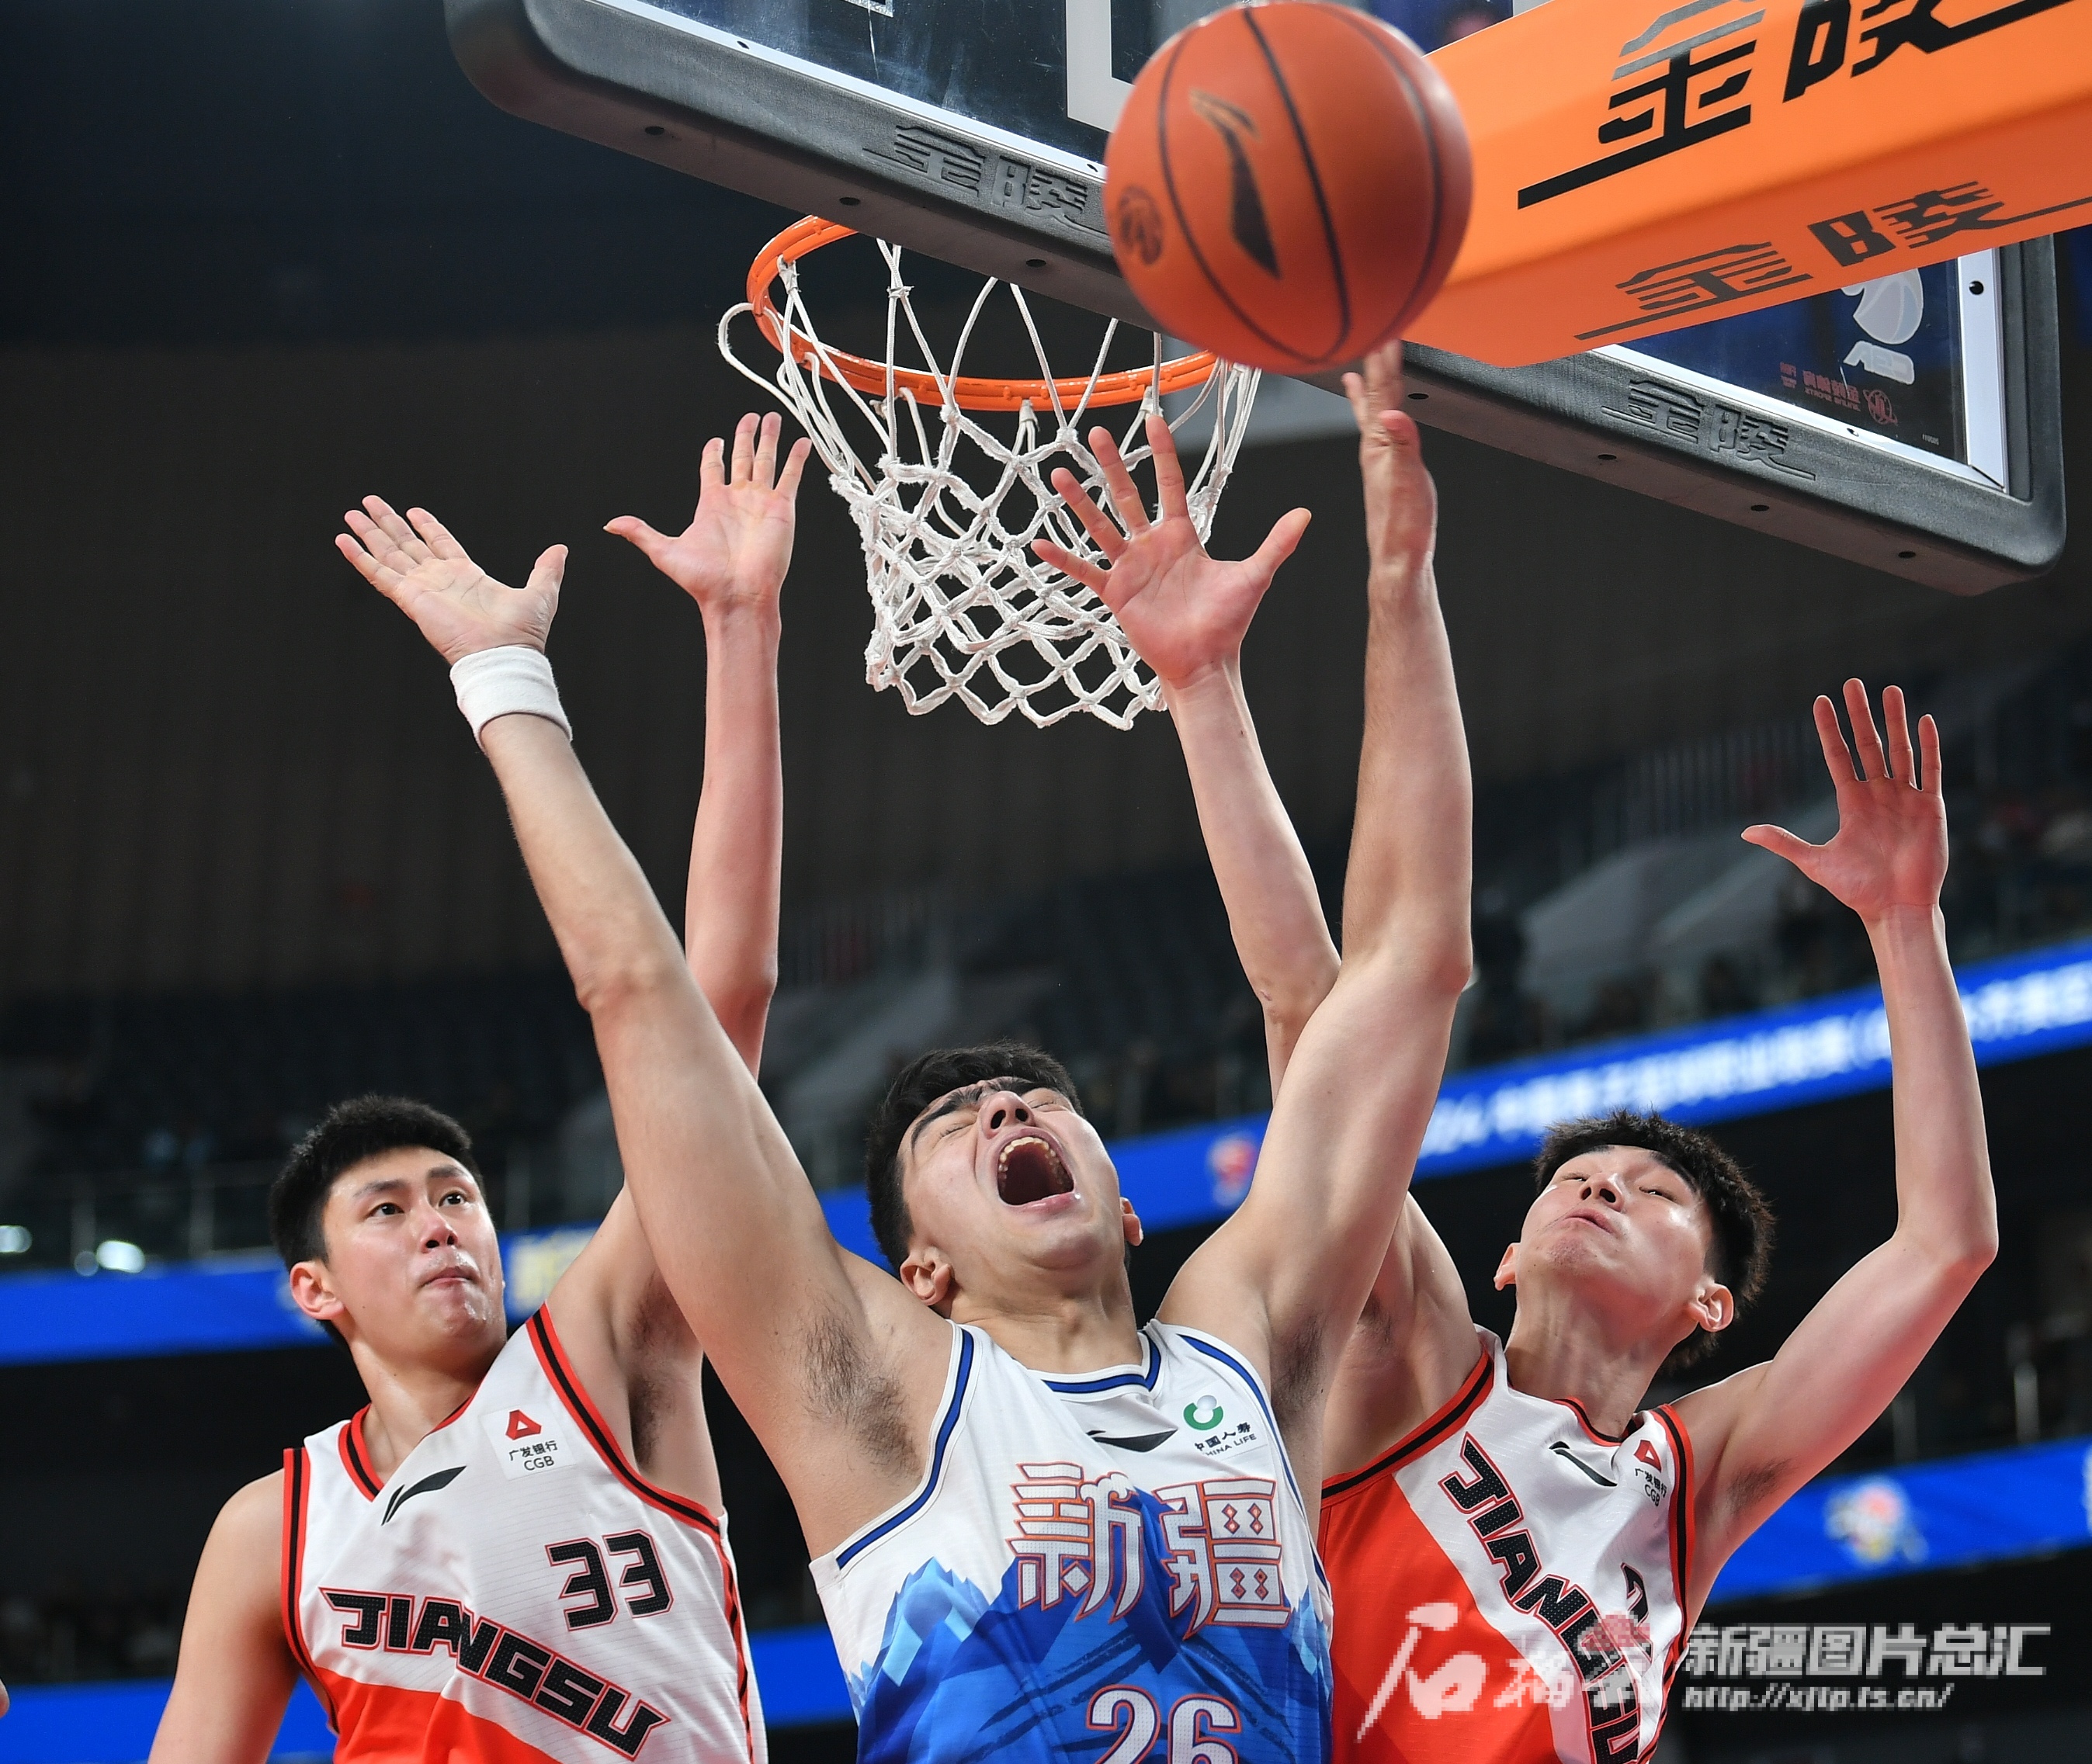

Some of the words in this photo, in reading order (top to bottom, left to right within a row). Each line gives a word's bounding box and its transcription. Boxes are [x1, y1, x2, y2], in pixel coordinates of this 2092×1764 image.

[862, 124, 1112, 236] 金陵
[1574, 181, 2092, 341] 金陵
[1601, 379, 1817, 482] 金陵
[508, 1440, 558, 1461] 广发银行
[524, 1456, 554, 1471] CGB
[1202, 1444, 1232, 1456] HINA
[1233, 1433, 1257, 1447] LIFE
[1645, 1484, 1660, 1506] CGB
[545, 1529, 675, 1631] 33
[1005, 1462, 1292, 1640] 新疆
[319, 1586, 671, 1761] JIANGSU
[1087, 1684, 1242, 1764] 26
